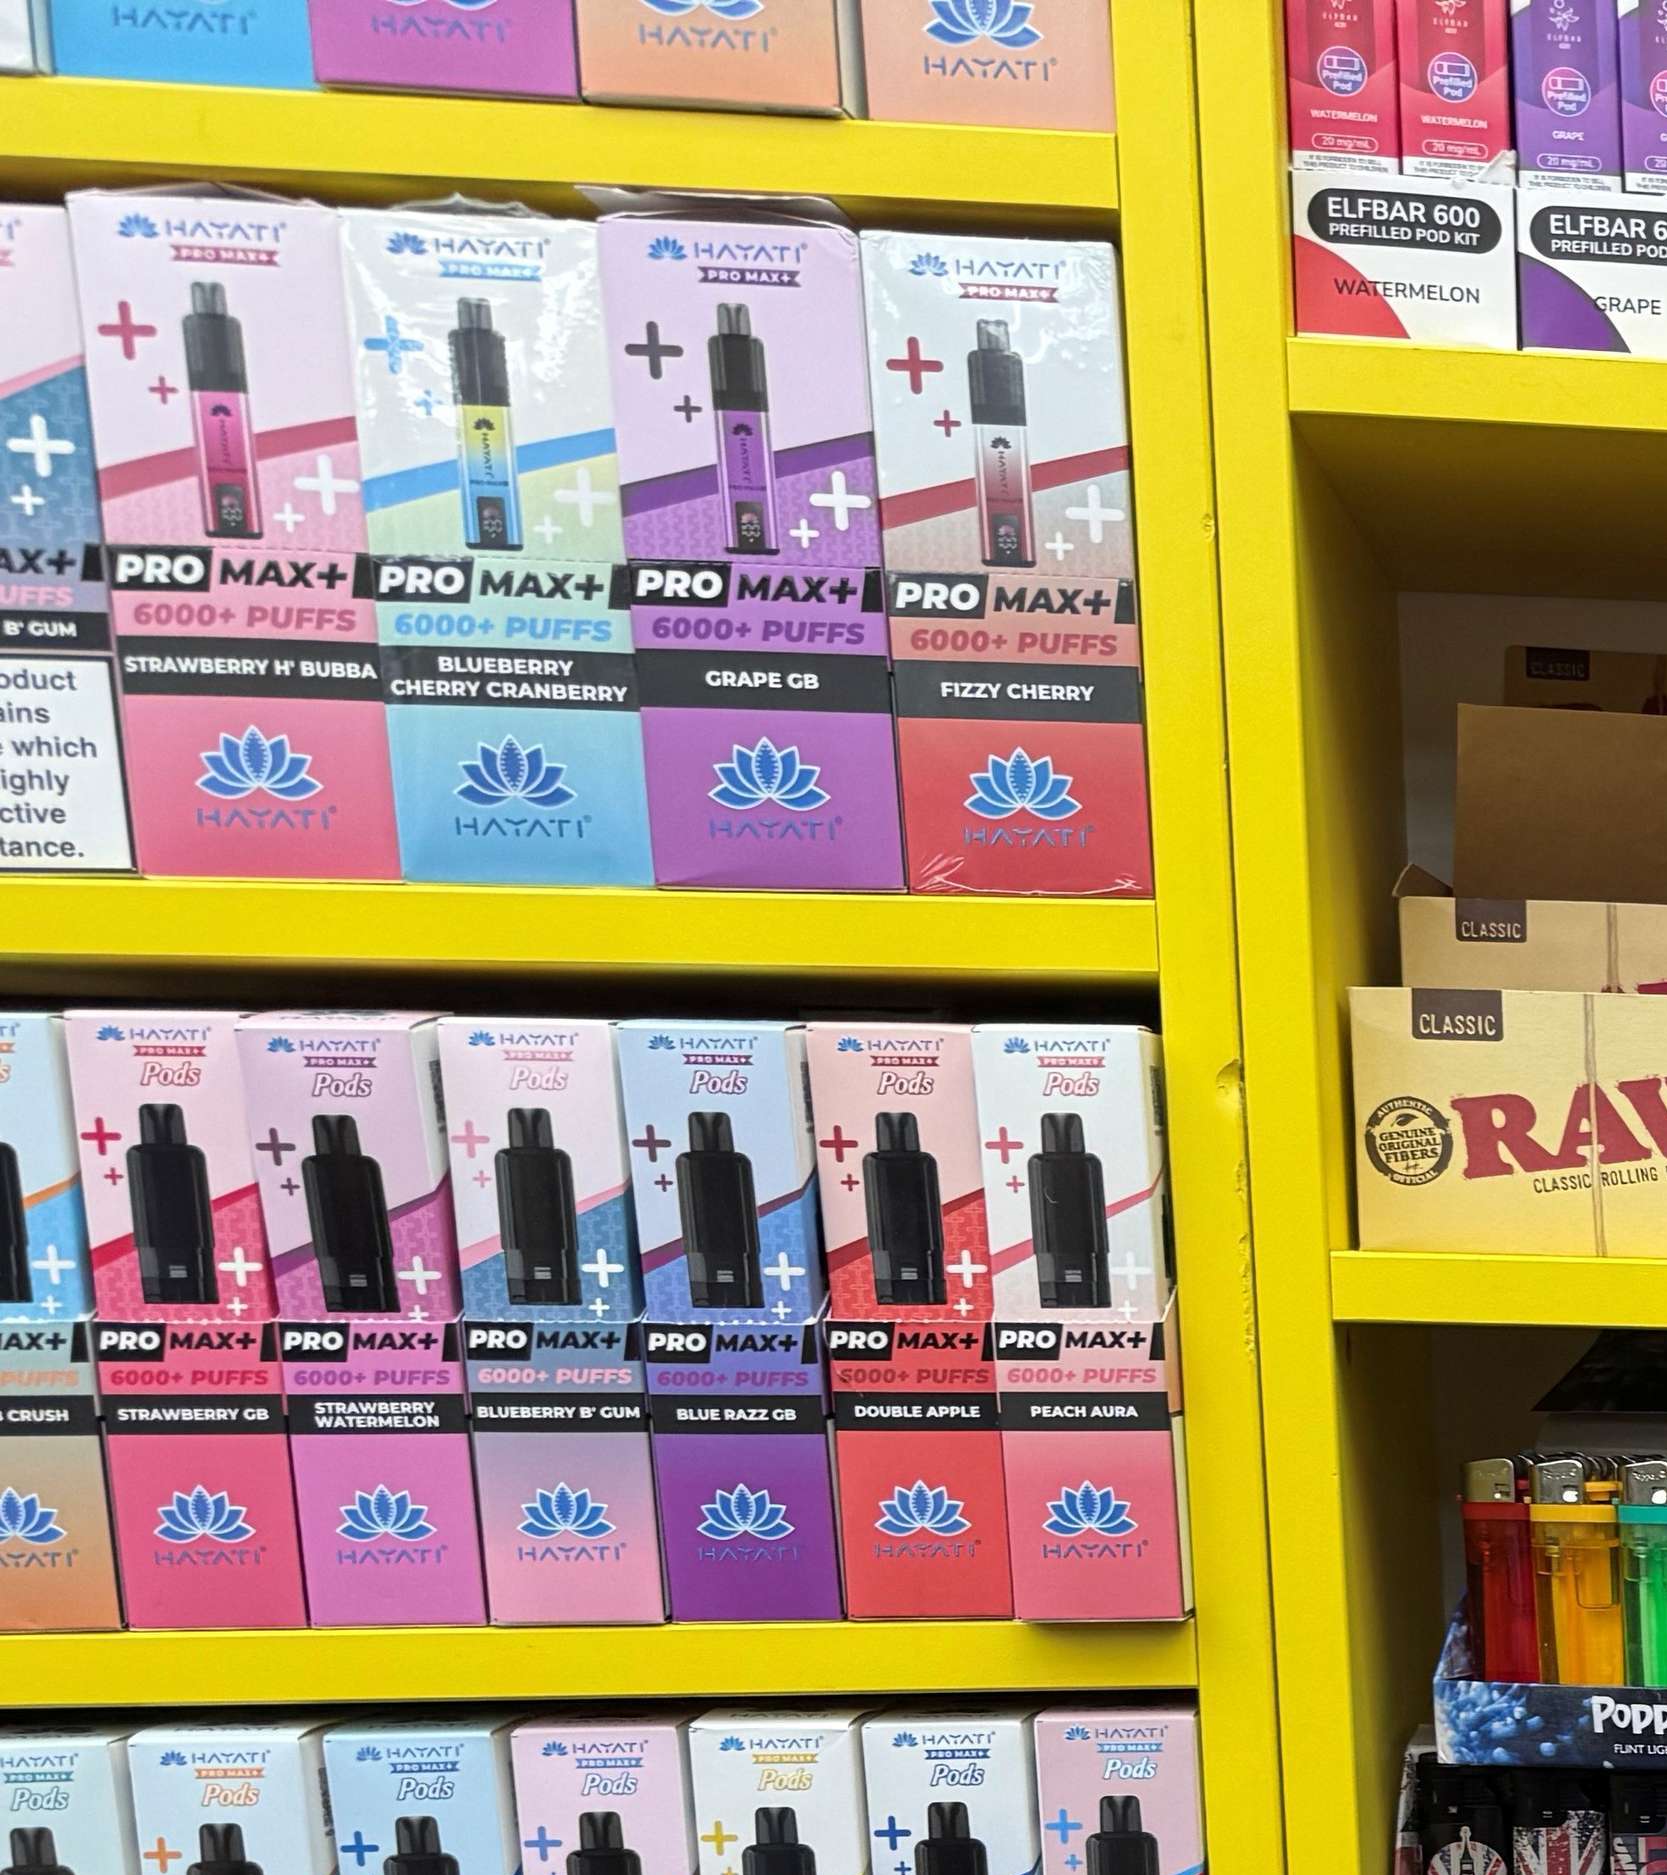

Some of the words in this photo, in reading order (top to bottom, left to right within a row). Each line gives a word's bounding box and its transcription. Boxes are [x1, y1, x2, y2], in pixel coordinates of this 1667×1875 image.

[1328, 198, 1426, 224] ELFBAR
[1433, 205, 1480, 228] 600
[1329, 223, 1411, 241] PREFILLED
[1415, 227, 1450, 243] POD
[1454, 230, 1480, 246] KIT
[1334, 278, 1480, 304] WATERMELON
[1595, 296, 1661, 316] GRAPE
[116, 554, 204, 584] PRO
[219, 559, 348, 590] MAX+
[134, 603, 236, 627] 6000+
[247, 606, 356, 632] PUFFS
[125, 656, 270, 675] STRAWBERRY
[301, 661, 378, 680] BUBBA
[437, 656, 573, 676] BLUEBERRY
[390, 679, 481, 698] CHERRY
[486, 680, 628, 703] CRANBERRY
[705, 671, 782, 689] GRAPE
[787, 673, 820, 690] GB
[940, 682, 1001, 699] FIZZY
[1006, 683, 1095, 702] CHERRY
[12, 736, 97, 759] which
[1419, 1014, 1496, 1037] CLASSIC
[140, 1064, 201, 1086] Pods
[1533, 1172, 1592, 1194] CLASSIC
[1602, 1166, 1658, 1188] ROLLING
[100, 1330, 161, 1350] PRO
[170, 1332, 257, 1350] MAX+
[118, 1408, 237, 1421] STRAWBERRY
[242, 1408, 269, 1421] GB
[315, 1402, 435, 1415] STRAWBERRY
[1030, 1405, 1087, 1418] PEACH
[1091, 1405, 1138, 1418] AURA
[315, 1415, 440, 1429] WATERMELON
[1614, 1744, 1644, 1757] FLINT
